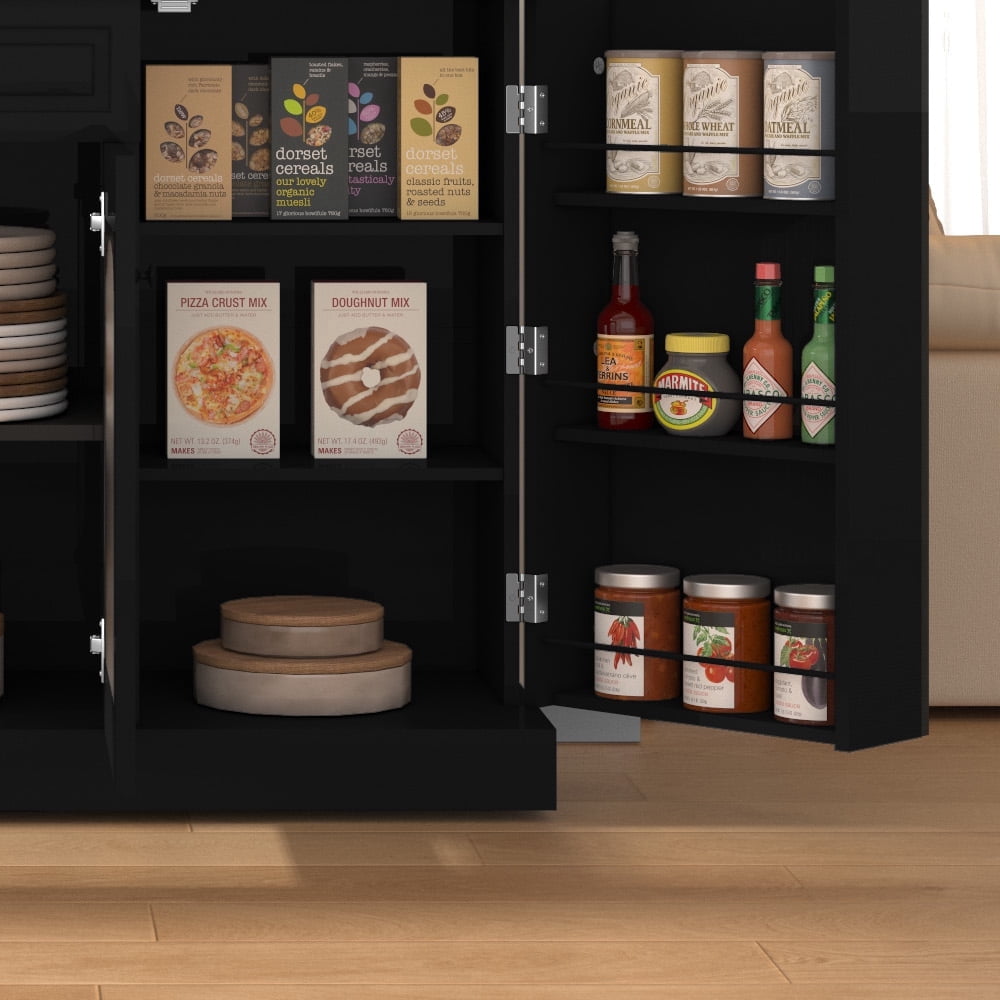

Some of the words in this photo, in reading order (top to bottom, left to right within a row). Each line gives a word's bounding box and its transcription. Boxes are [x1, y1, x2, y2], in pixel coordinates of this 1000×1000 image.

[701, 121, 735, 132] WHEAT
[275, 147, 328, 160] dorset
[348, 145, 382, 158] rset
[405, 147, 458, 160] dorset
[275, 162, 334, 175] cereals
[348, 160, 388, 173] reals
[405, 162, 464, 175] cereals
[153, 173, 185, 182] dorset
[191, 173, 223, 182] cereals
[296, 177, 327, 187] lovely
[406, 177, 441, 186] classic
[443, 177, 475, 187] fruits,
[153, 182, 192, 190] chocolate
[193, 182, 225, 191] granola
[406, 187, 445, 196] roasted
[447, 188, 471, 196] nuts
[153, 190, 162, 198] &
[162, 190, 208, 198] macadamia
[209, 190, 227, 198] nuts
[276, 188, 315, 197] organic
[276, 198, 312, 207] muesli
[406, 198, 415, 206] &
[417, 197, 446, 206] seeds
[180, 297, 209, 308] PIZZA
[211, 297, 245, 308] CRUST
[248, 297, 268, 308] MIX
[332, 297, 388, 308] DOUGHNUT
[391, 297, 410, 308] MIX
[171, 447, 195, 455] MAKES
[318, 447, 342, 455] MAKES
